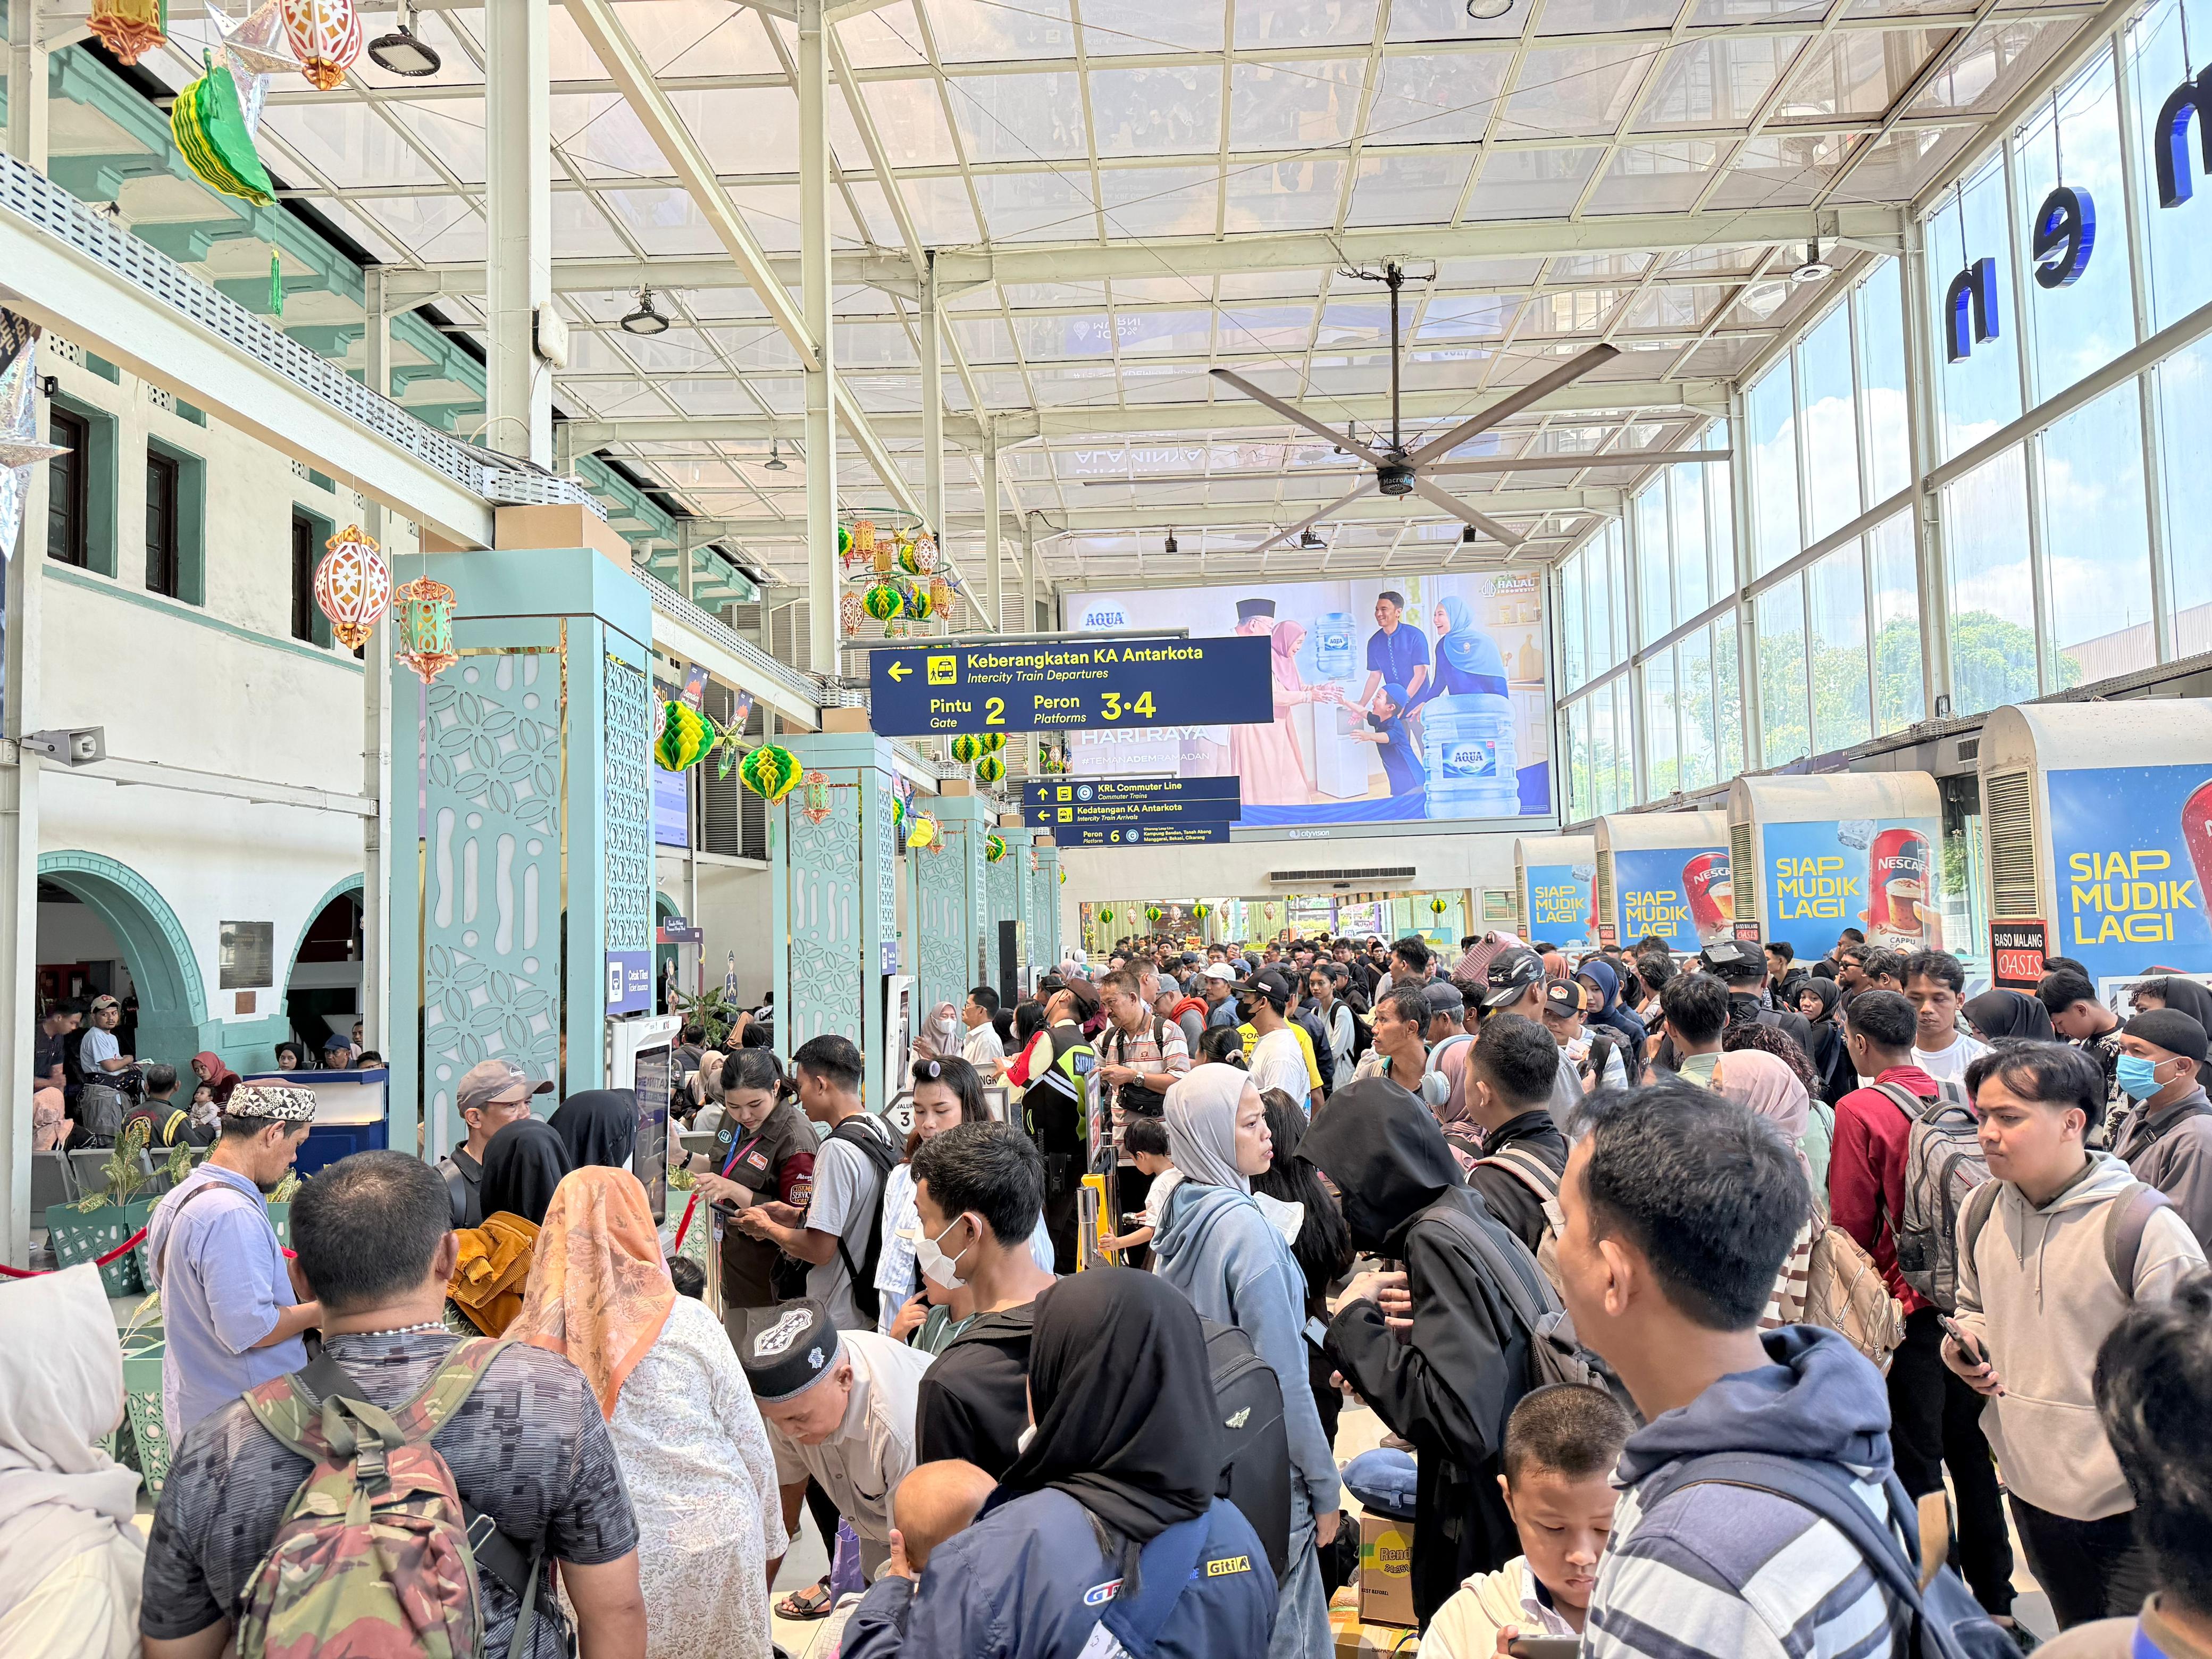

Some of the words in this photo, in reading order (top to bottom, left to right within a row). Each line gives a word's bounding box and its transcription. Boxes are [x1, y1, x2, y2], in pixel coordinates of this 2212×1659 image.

[1498, 579, 1535, 588] HALAL
[1085, 612, 1124, 627] AQUA
[967, 651, 1089, 670] Keberangkatan
[1094, 649, 1118, 663] KA
[1122, 646, 1203, 662] Antarkota
[967, 671, 1014, 684] Intercity
[1017, 670, 1044, 682] Train
[1047, 668, 1109, 682] Departures
[930, 698, 972, 713] Pintu
[985, 697, 1006, 724] 2
[1034, 695, 1080, 709] Peron
[930, 716, 957, 728] Gate
[1034, 711, 1087, 724] Platforms
[1082, 727, 1139, 744] HARI
[1147, 726, 1210, 742] RAYA
[1082, 753, 1209, 765] #TEMANADEMRAMADAN
[1454, 752, 1483, 763] AQUA
[1098, 784, 1115, 792] KRL
[1117, 783, 1162, 792] Commuter
[1077, 806, 1126, 816] Kedatangan
[1142, 803, 1182, 812] Antarkota
[1110, 830, 1120, 842] 6
[1776, 857, 1845, 878] SIAP
[2069, 850, 2171, 881] SIAP
[1694, 867, 1730, 884] NESCA
[1535, 885, 1576, 899] SIAP
[1777, 877, 1860, 898] MUDIK
[1536, 898, 1586, 911] MUDIK
[1625, 891, 1676, 907] SIAP
[2071, 880, 2197, 913] MUDIK
[1537, 910, 1577, 923] LAGI
[1626, 906, 1688, 922] MUDIK
[1779, 898, 1846, 919] LAGI
[1627, 922, 1677, 938] LAGI
[2074, 912, 2174, 944] LAGI
[1995, 934, 2013, 947] BASO
[2013, 934, 2042, 948] MALANG
[1999, 953, 2042, 977] OASIS
[901, 1112, 910, 1126] 3
[1380, 1547, 1413, 1561] Rend
